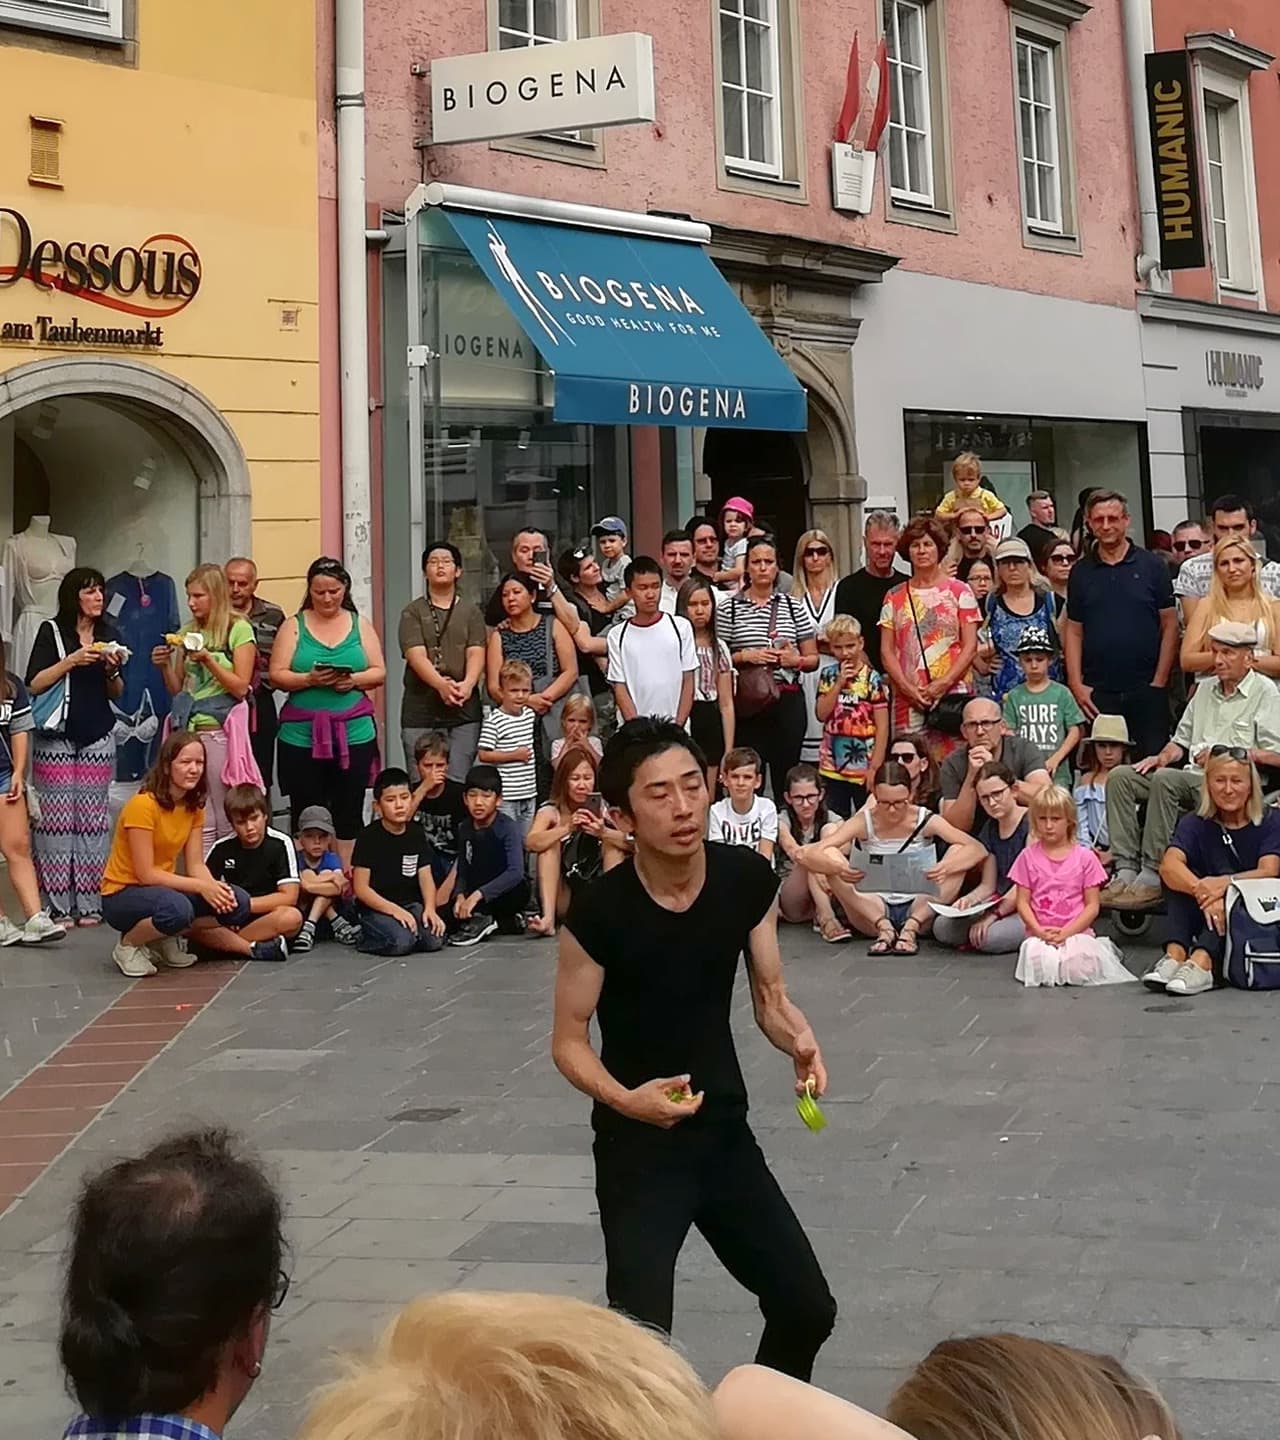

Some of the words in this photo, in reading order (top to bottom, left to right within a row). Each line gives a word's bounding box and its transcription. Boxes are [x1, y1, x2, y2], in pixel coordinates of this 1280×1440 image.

[443, 64, 627, 112] BIOGENA
[1153, 79, 1194, 241] HUMANIC
[536, 269, 706, 317] BIOGENA
[0, 318, 33, 342] am
[36, 315, 164, 348] Taubenmarkt
[566, 311, 605, 329] GOOD
[613, 316, 664, 334] HEALTH
[669, 321, 697, 337] FOR
[703, 325, 721, 338] ME
[1206, 350, 1264, 390] HUMANIC
[628, 383, 747, 420] BIOGENA
[1019, 704, 1058, 723] SURF
[1020, 724, 1058, 744] DAYS
